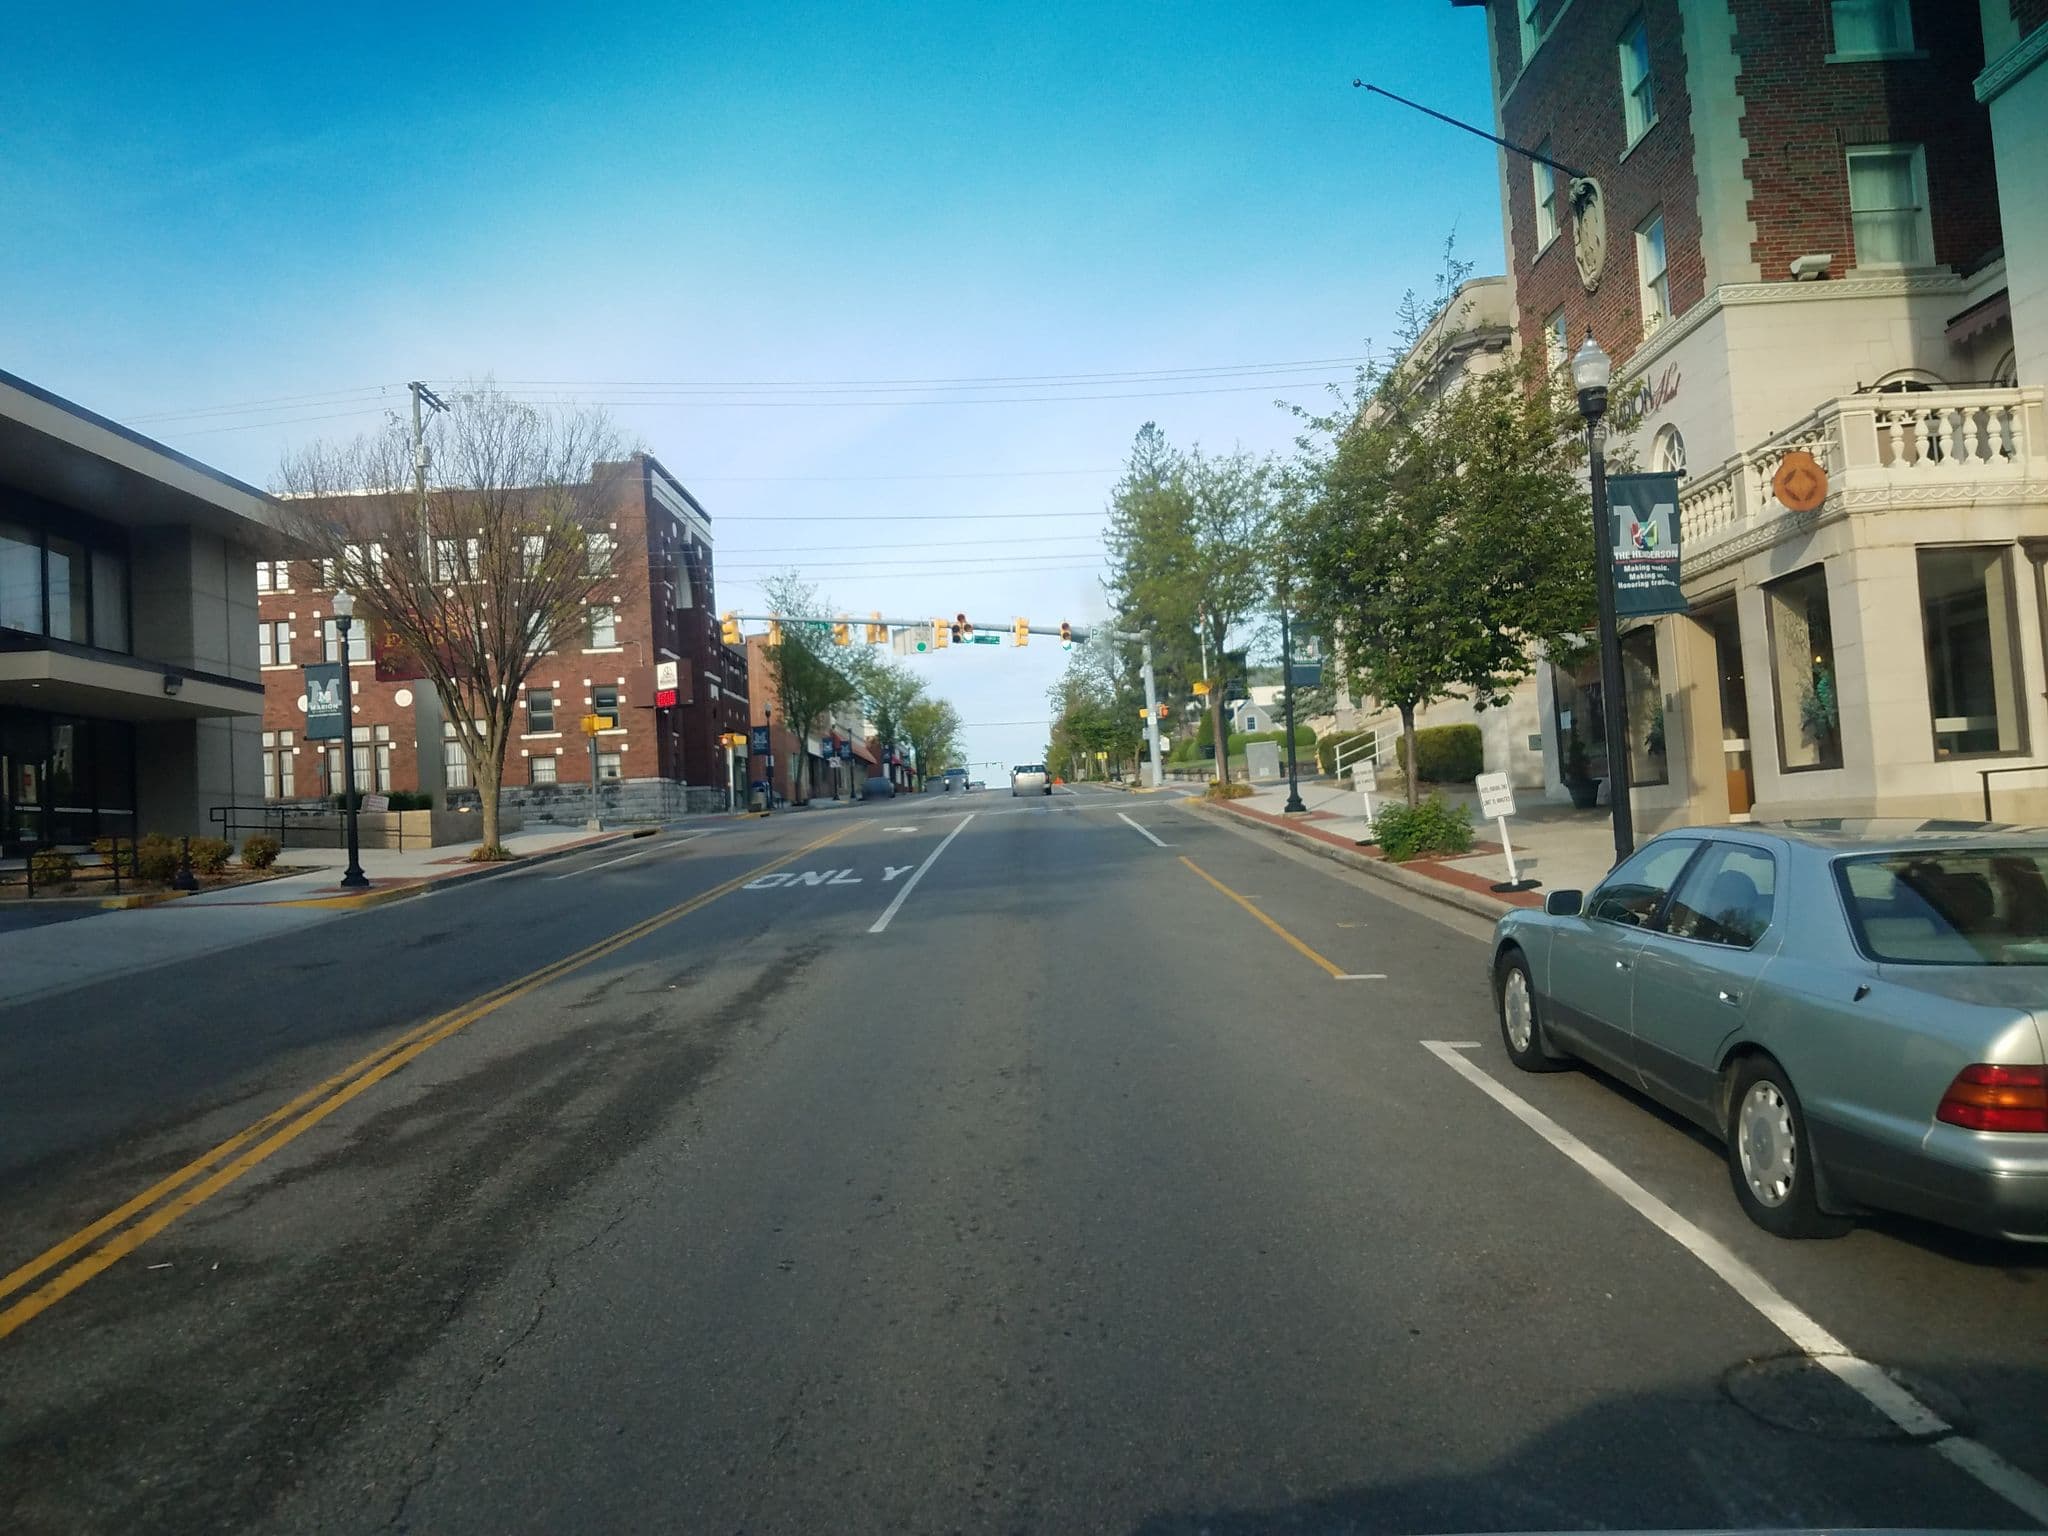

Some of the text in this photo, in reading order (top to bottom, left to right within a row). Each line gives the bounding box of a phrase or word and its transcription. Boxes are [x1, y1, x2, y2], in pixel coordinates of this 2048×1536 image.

[1615, 551, 1630, 560] THE
[1624, 564, 1651, 572] Making
[1629, 571, 1656, 580] Making
[742, 865, 914, 889] ONLY
